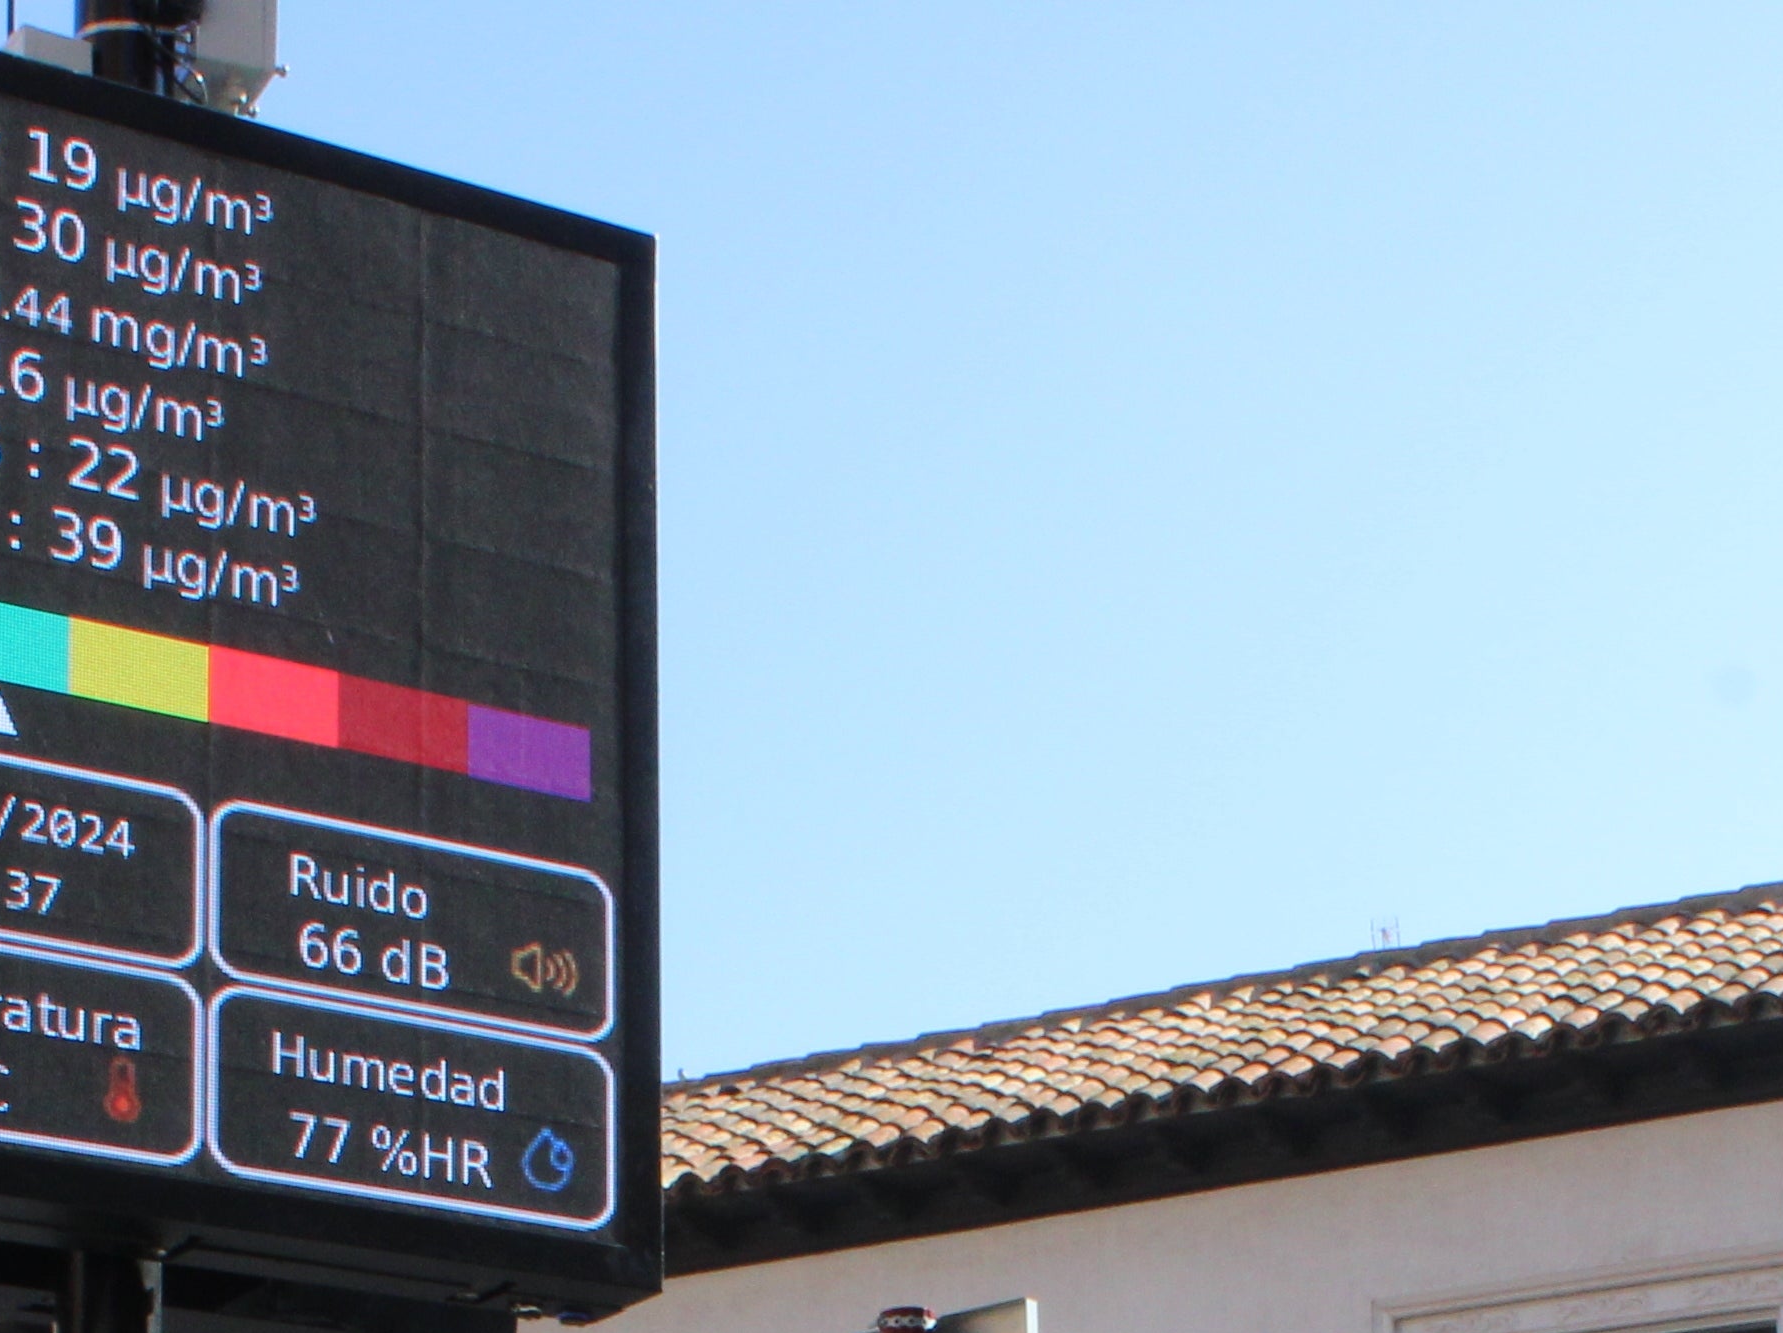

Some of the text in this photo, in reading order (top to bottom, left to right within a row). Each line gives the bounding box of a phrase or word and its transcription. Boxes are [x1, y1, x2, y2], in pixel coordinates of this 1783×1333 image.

[27, 128, 98, 191] 19
[12, 198, 86, 262] 30
[90, 307, 269, 378] mg/m³
[28, 440, 41, 479] :
[67, 436, 139, 501] 22
[9, 512, 22, 550] :
[49, 507, 123, 570] 39
[288, 852, 429, 919] Ruido
[297, 921, 450, 990] 66 dB
[271, 1030, 506, 1113] Humedad
[288, 1110, 493, 1189] 77 %HR
